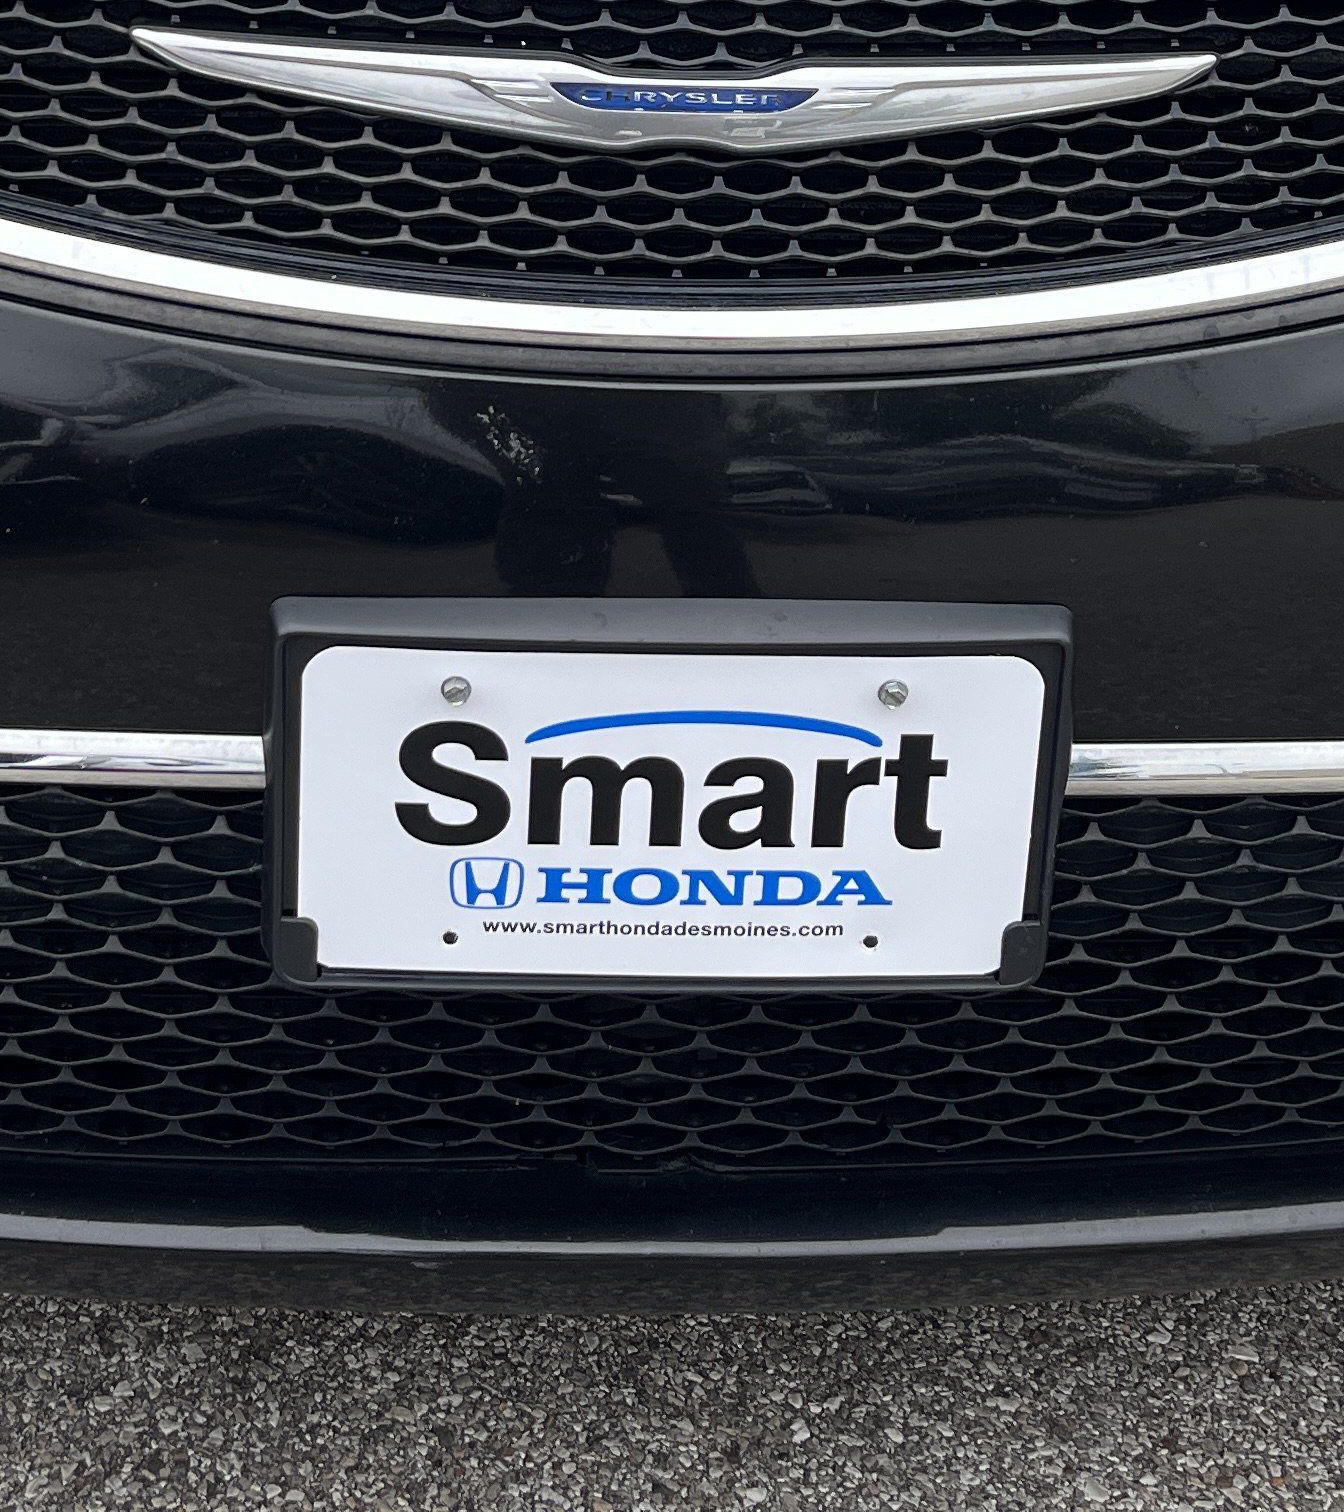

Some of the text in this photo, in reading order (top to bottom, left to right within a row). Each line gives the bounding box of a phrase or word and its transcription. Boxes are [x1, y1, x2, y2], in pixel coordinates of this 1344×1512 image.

[394, 720, 949, 851] Smart
[537, 867, 893, 907] HONDA
[481, 918, 845, 938] www.smarthondadesmoines.com
